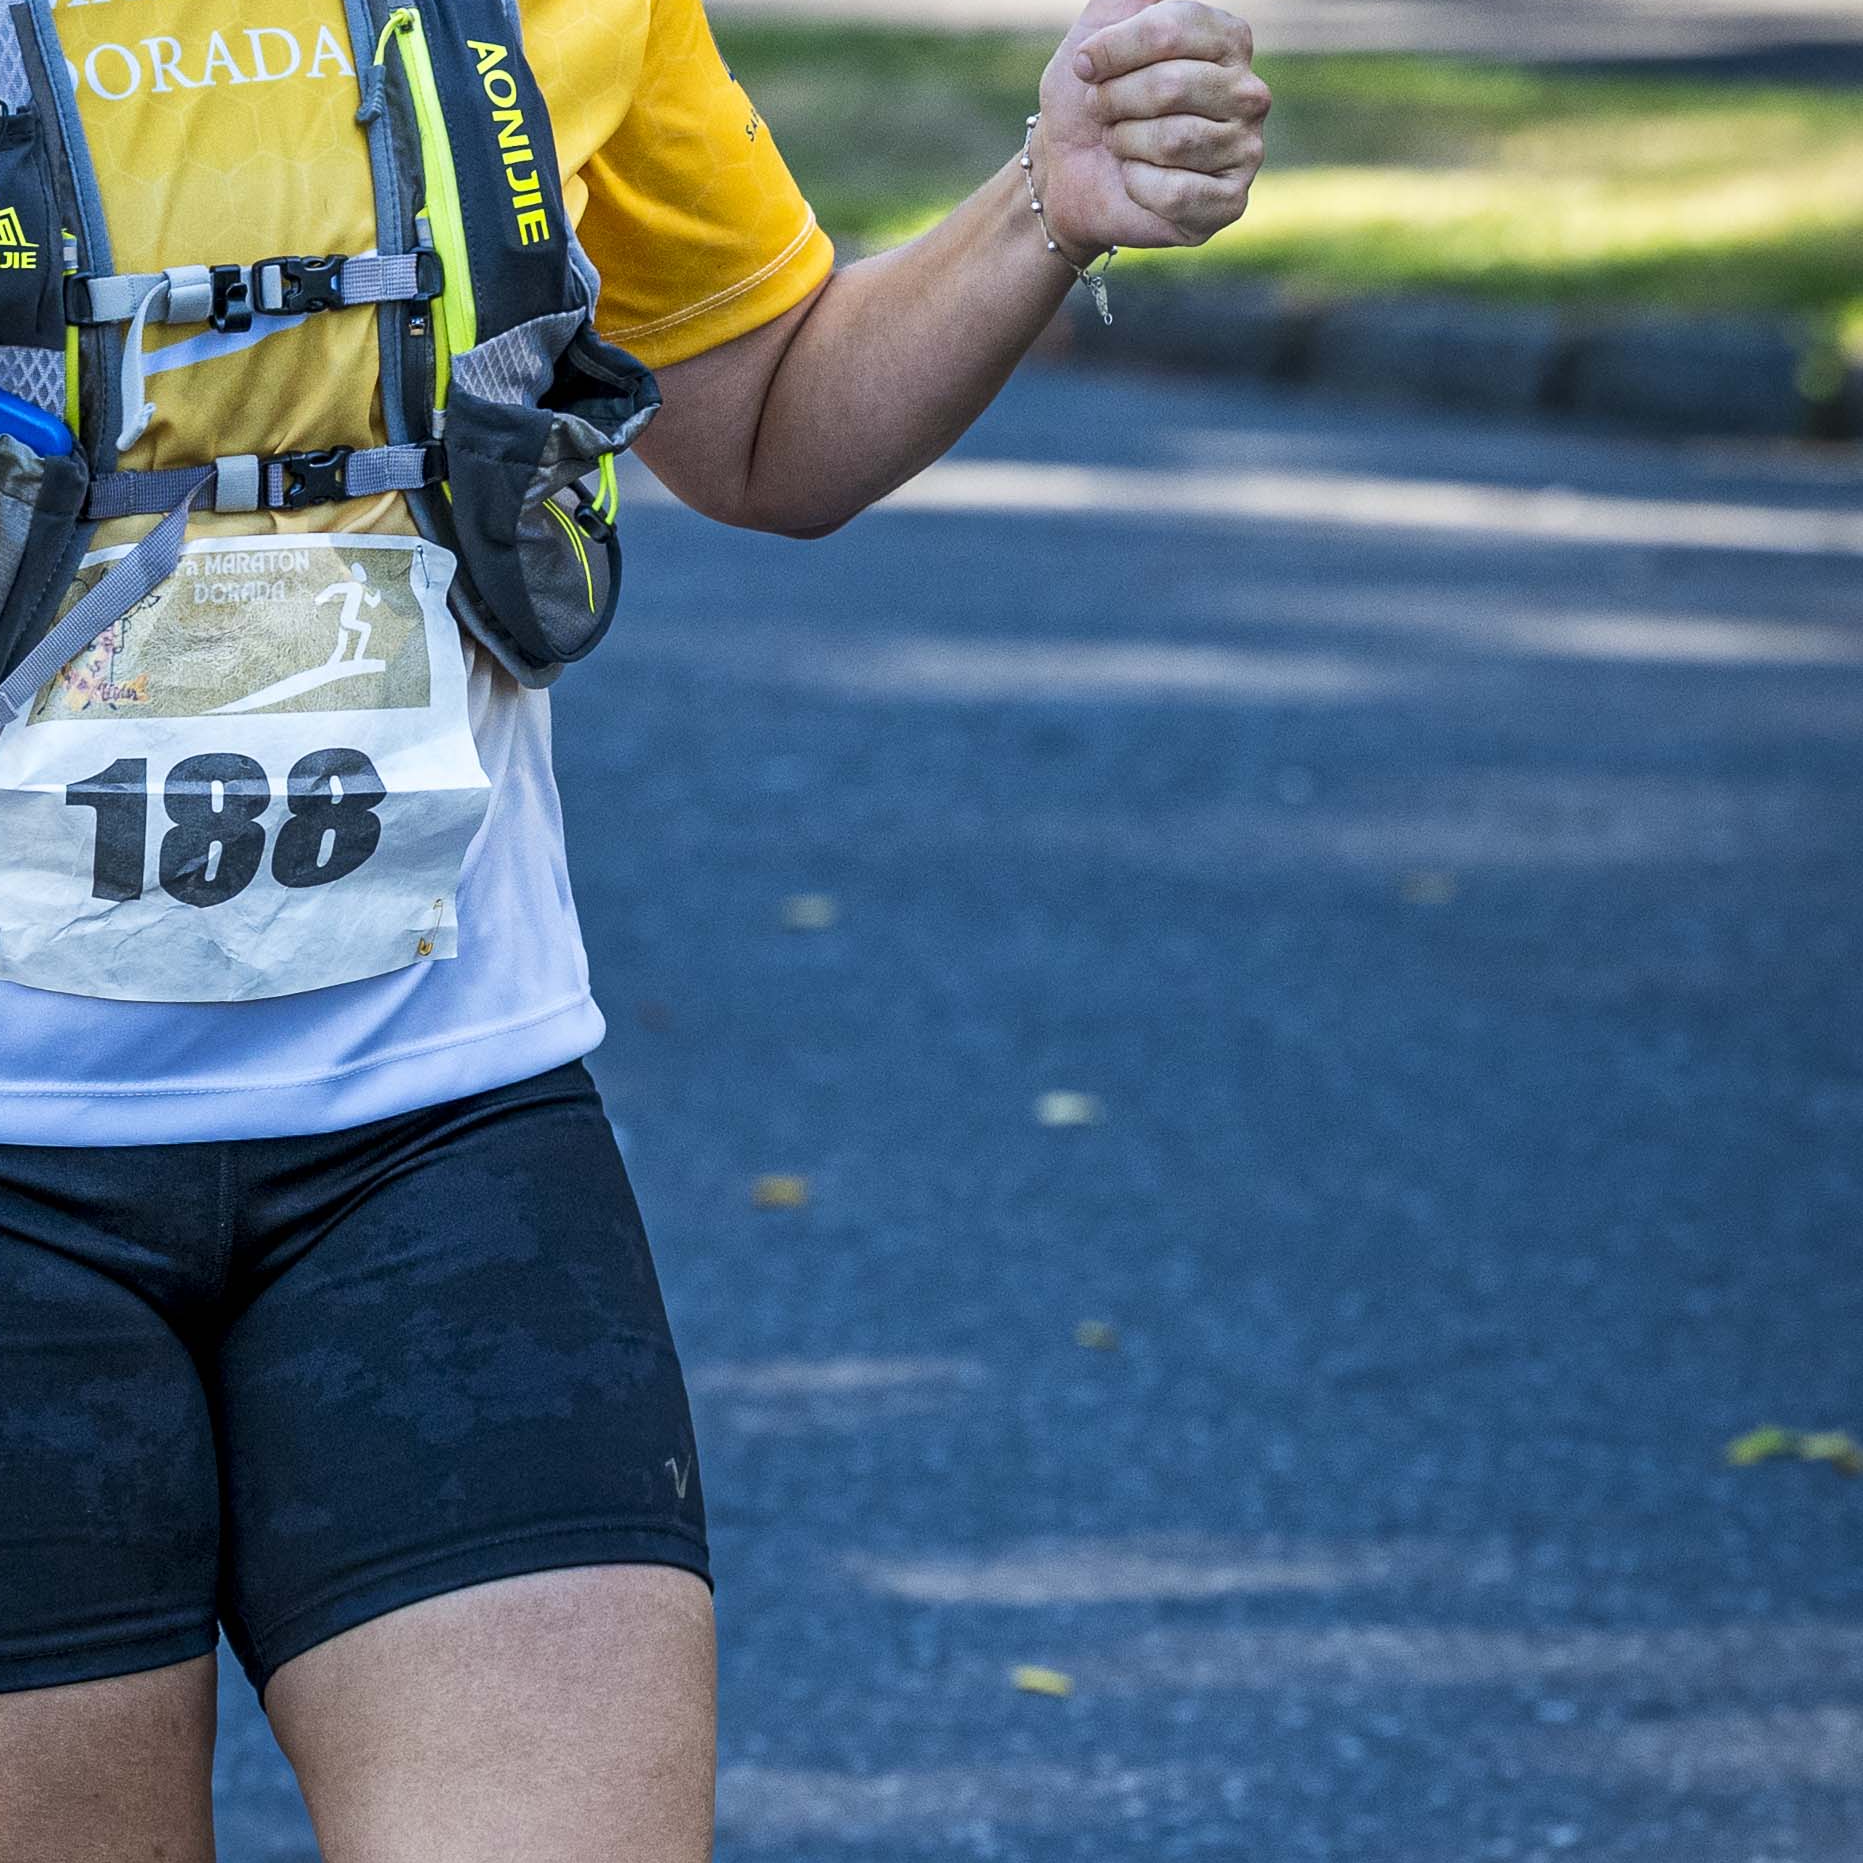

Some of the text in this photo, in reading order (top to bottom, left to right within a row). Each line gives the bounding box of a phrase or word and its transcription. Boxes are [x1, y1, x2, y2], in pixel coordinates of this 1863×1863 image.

[65, 24, 356, 101] ORADA
[466, 39, 551, 246] AONIJIE
[203, 549, 310, 576] MARATON
[65, 747, 388, 909] 188
